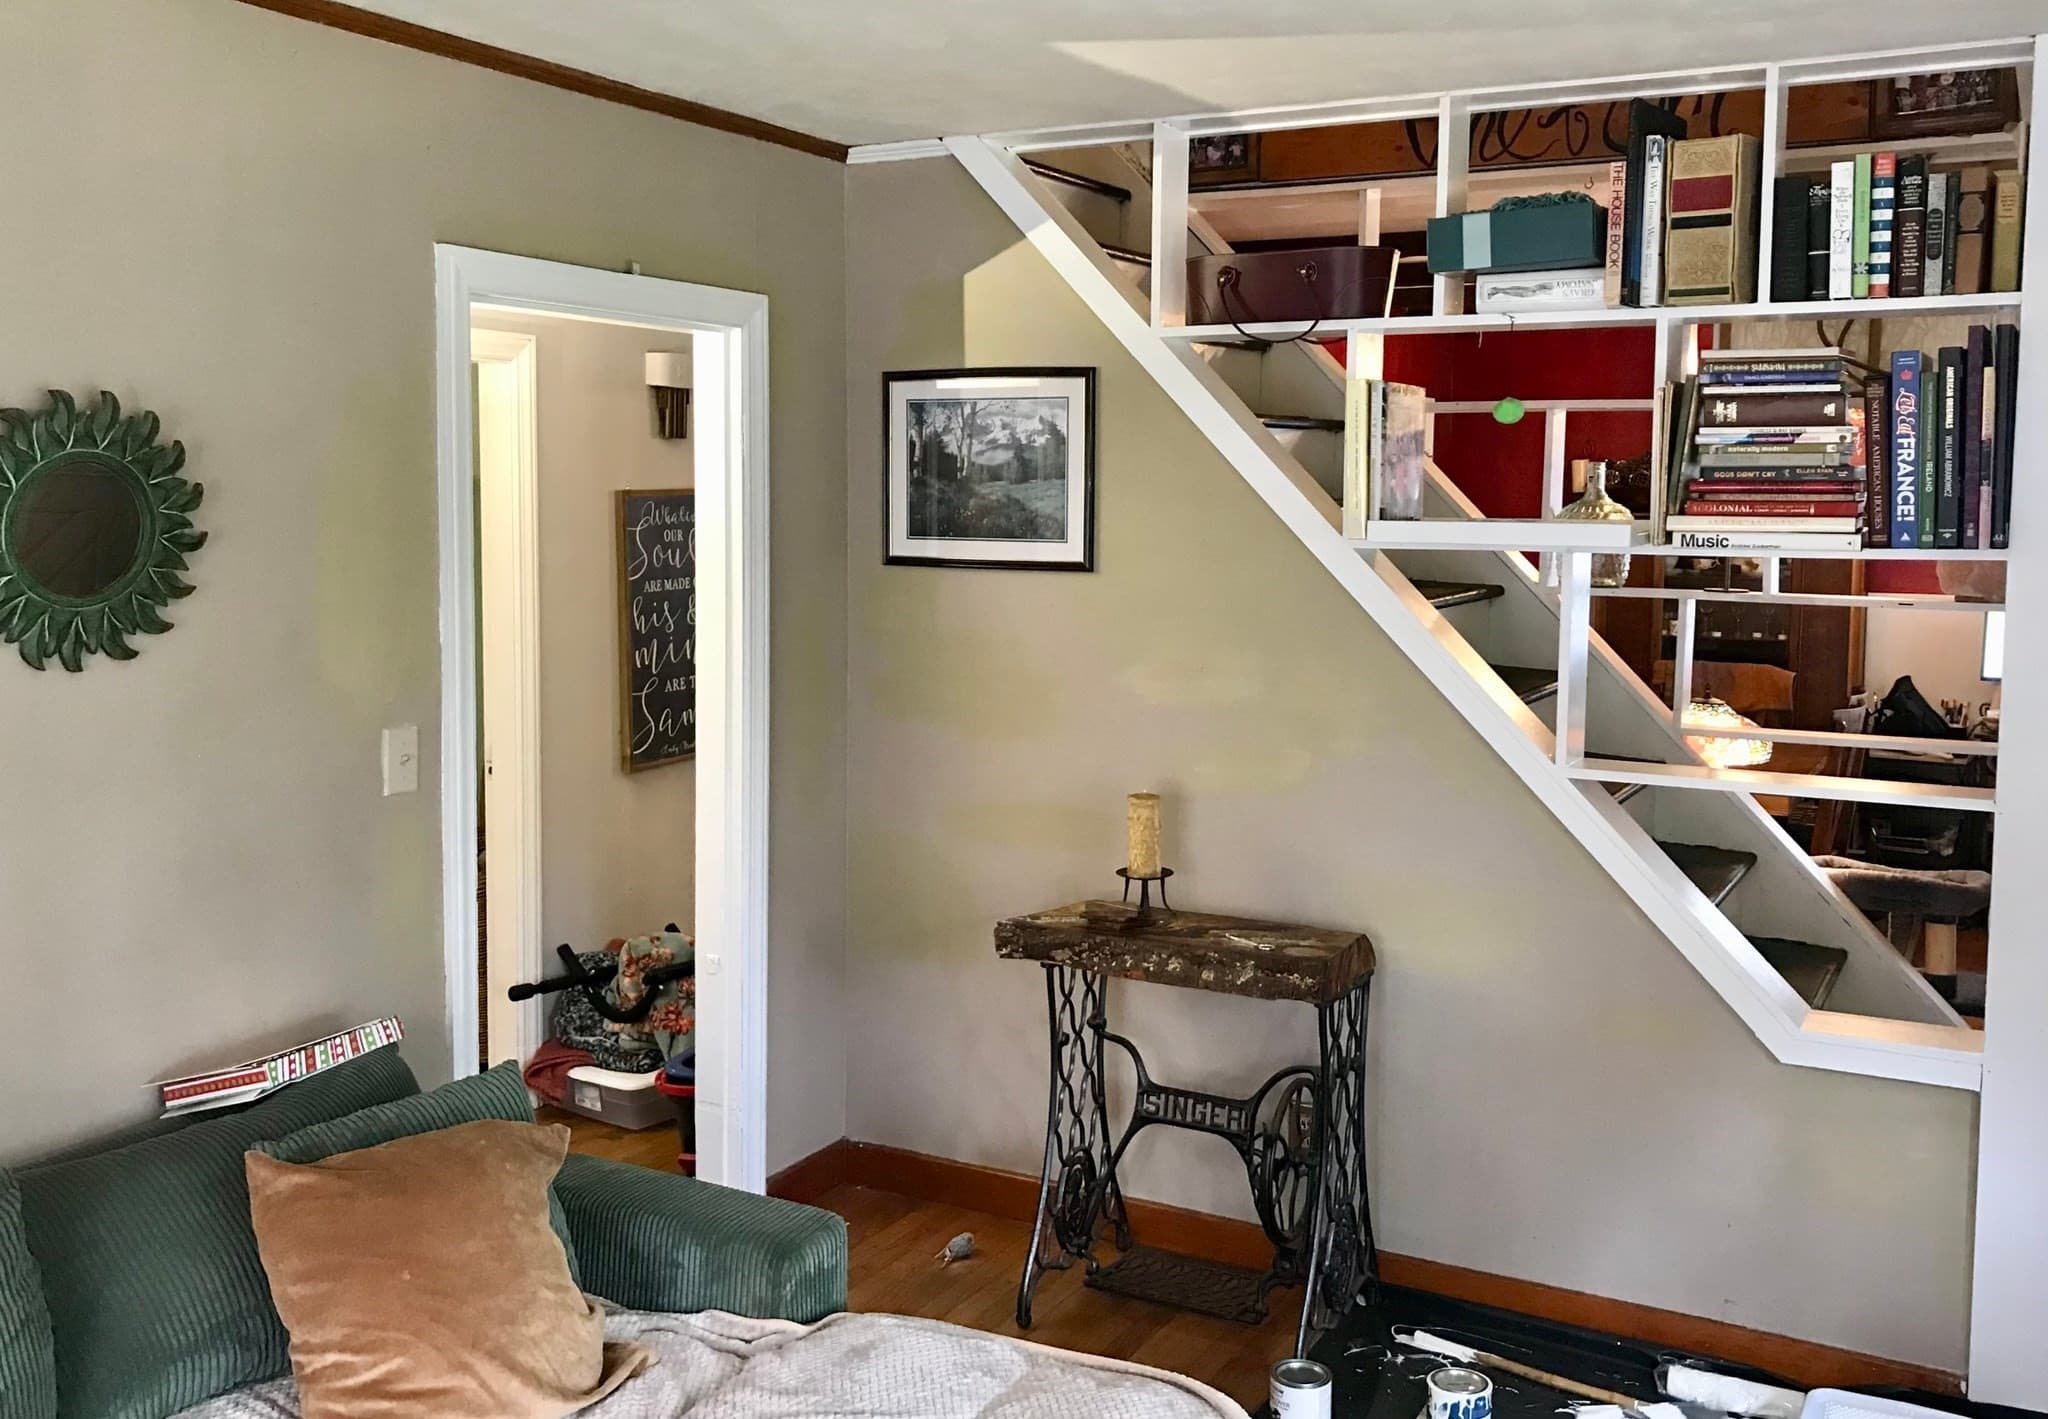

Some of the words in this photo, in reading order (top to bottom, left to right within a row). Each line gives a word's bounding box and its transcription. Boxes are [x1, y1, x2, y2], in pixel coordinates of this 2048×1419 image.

[1612, 165, 1623, 185] THE
[1610, 189, 1622, 231] HOUSE
[1608, 235, 1621, 268] BOOK
[1946, 366, 1955, 397] AMERICAN
[1871, 399, 1881, 440] NOTABLE
[1896, 416, 1916, 440] Eat
[1944, 435, 1953, 459] WILLIAM
[1872, 445, 1881, 492] AMERICAN
[1896, 438, 1916, 522] FRANCE!
[1925, 461, 1934, 493] IRELAND
[1873, 495, 1882, 529] HOUSES
[664, 529, 684, 543] OUR
[1680, 533, 1729, 548] Music
[644, 580, 662, 592] ARE
[664, 576, 691, 591] MADE
[633, 595, 682, 634] his
[664, 677, 686, 693] ARE
[1143, 1093, 1249, 1131] SINGER
